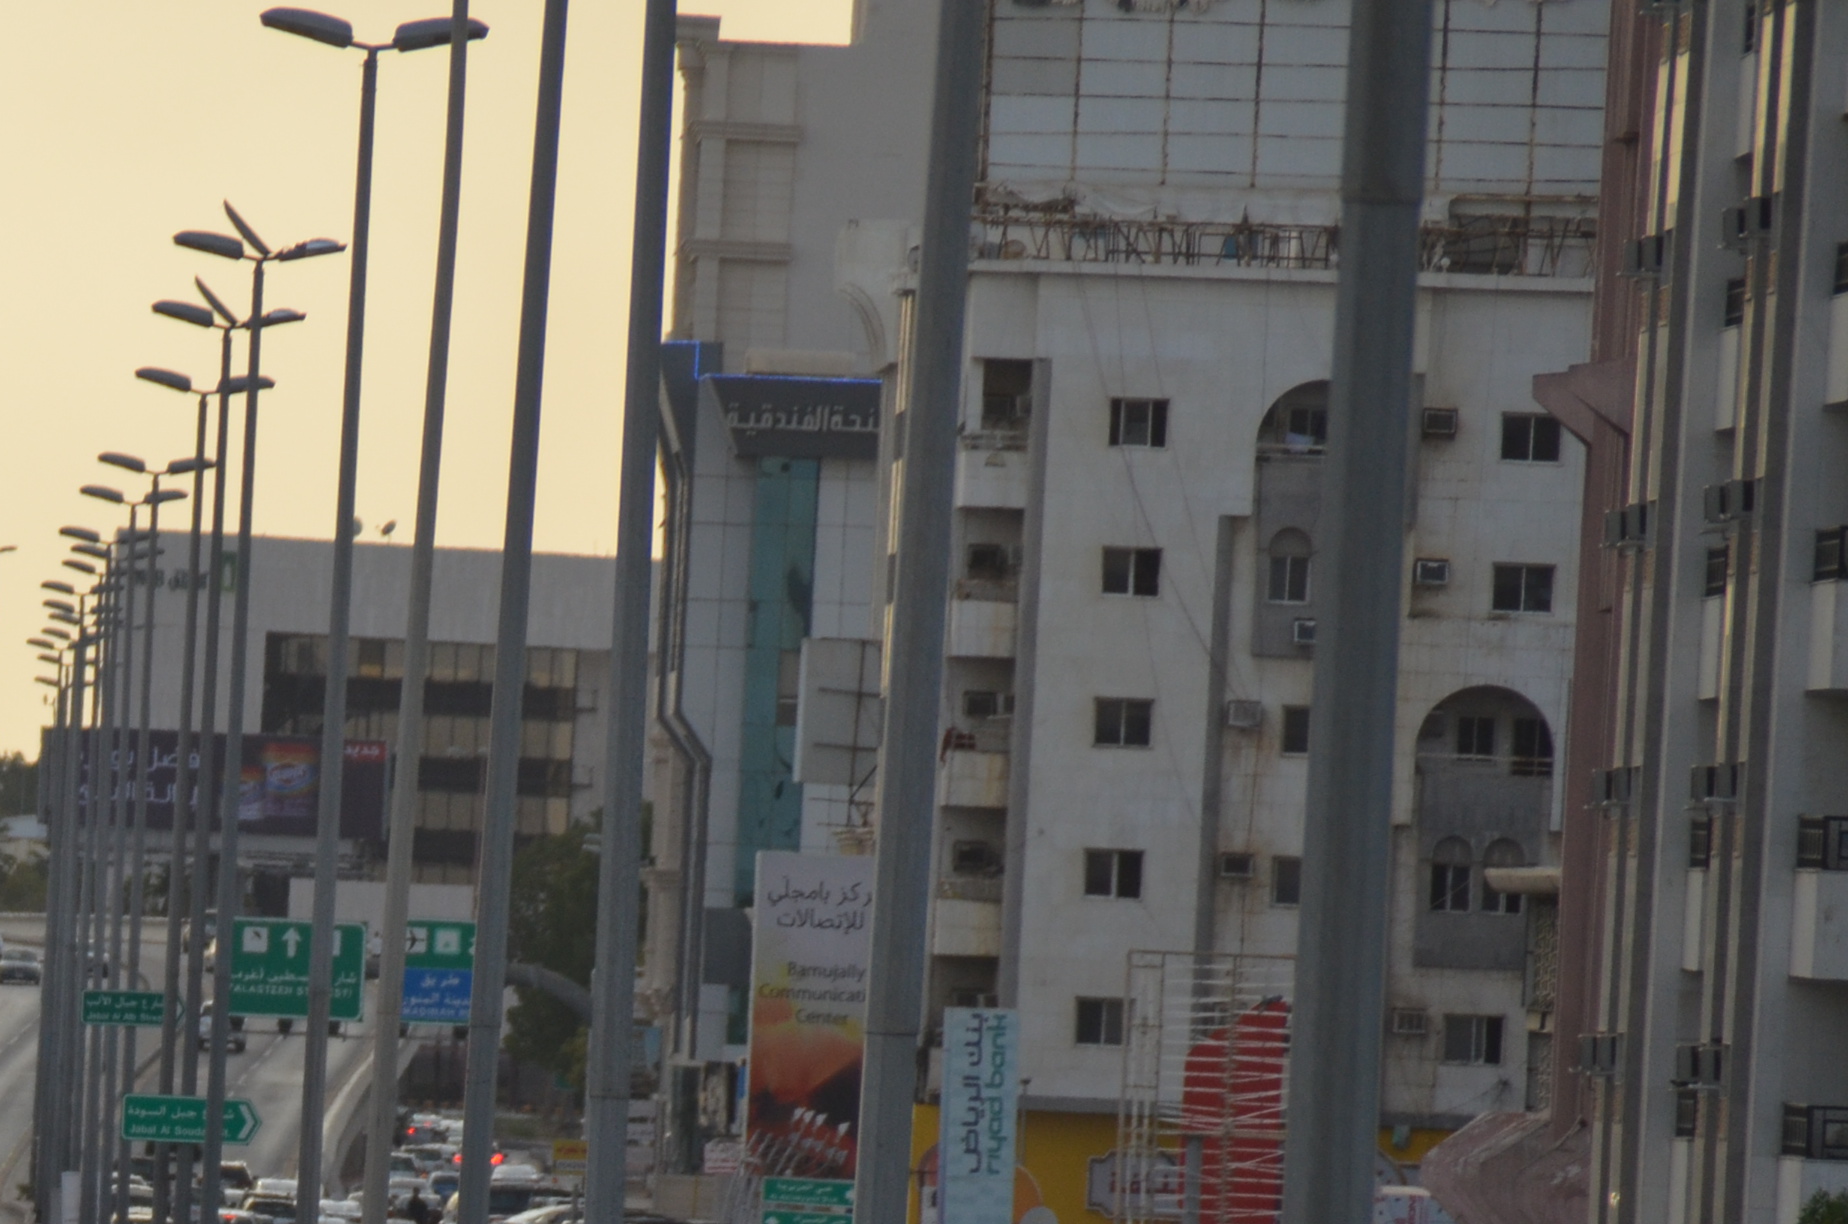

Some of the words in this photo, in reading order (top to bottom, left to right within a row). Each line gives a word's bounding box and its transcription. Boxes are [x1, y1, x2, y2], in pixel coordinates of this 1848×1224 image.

[837, 881, 872, 907] ركز
[333, 971, 357, 987] شار
[788, 961, 867, 983] Bamujally
[758, 983, 866, 1003] Communicati
[795, 1008, 850, 1025] Center
[964, 1012, 989, 1067] بنك
[984, 1013, 1008, 1090] bank
[131, 1124, 156, 1135] Jabal
[160, 1125, 170, 1135] Al
[174, 1125, 208, 1136] Souda
[961, 1075, 986, 1174] الرياض
[984, 1096, 1007, 1176] riyad
